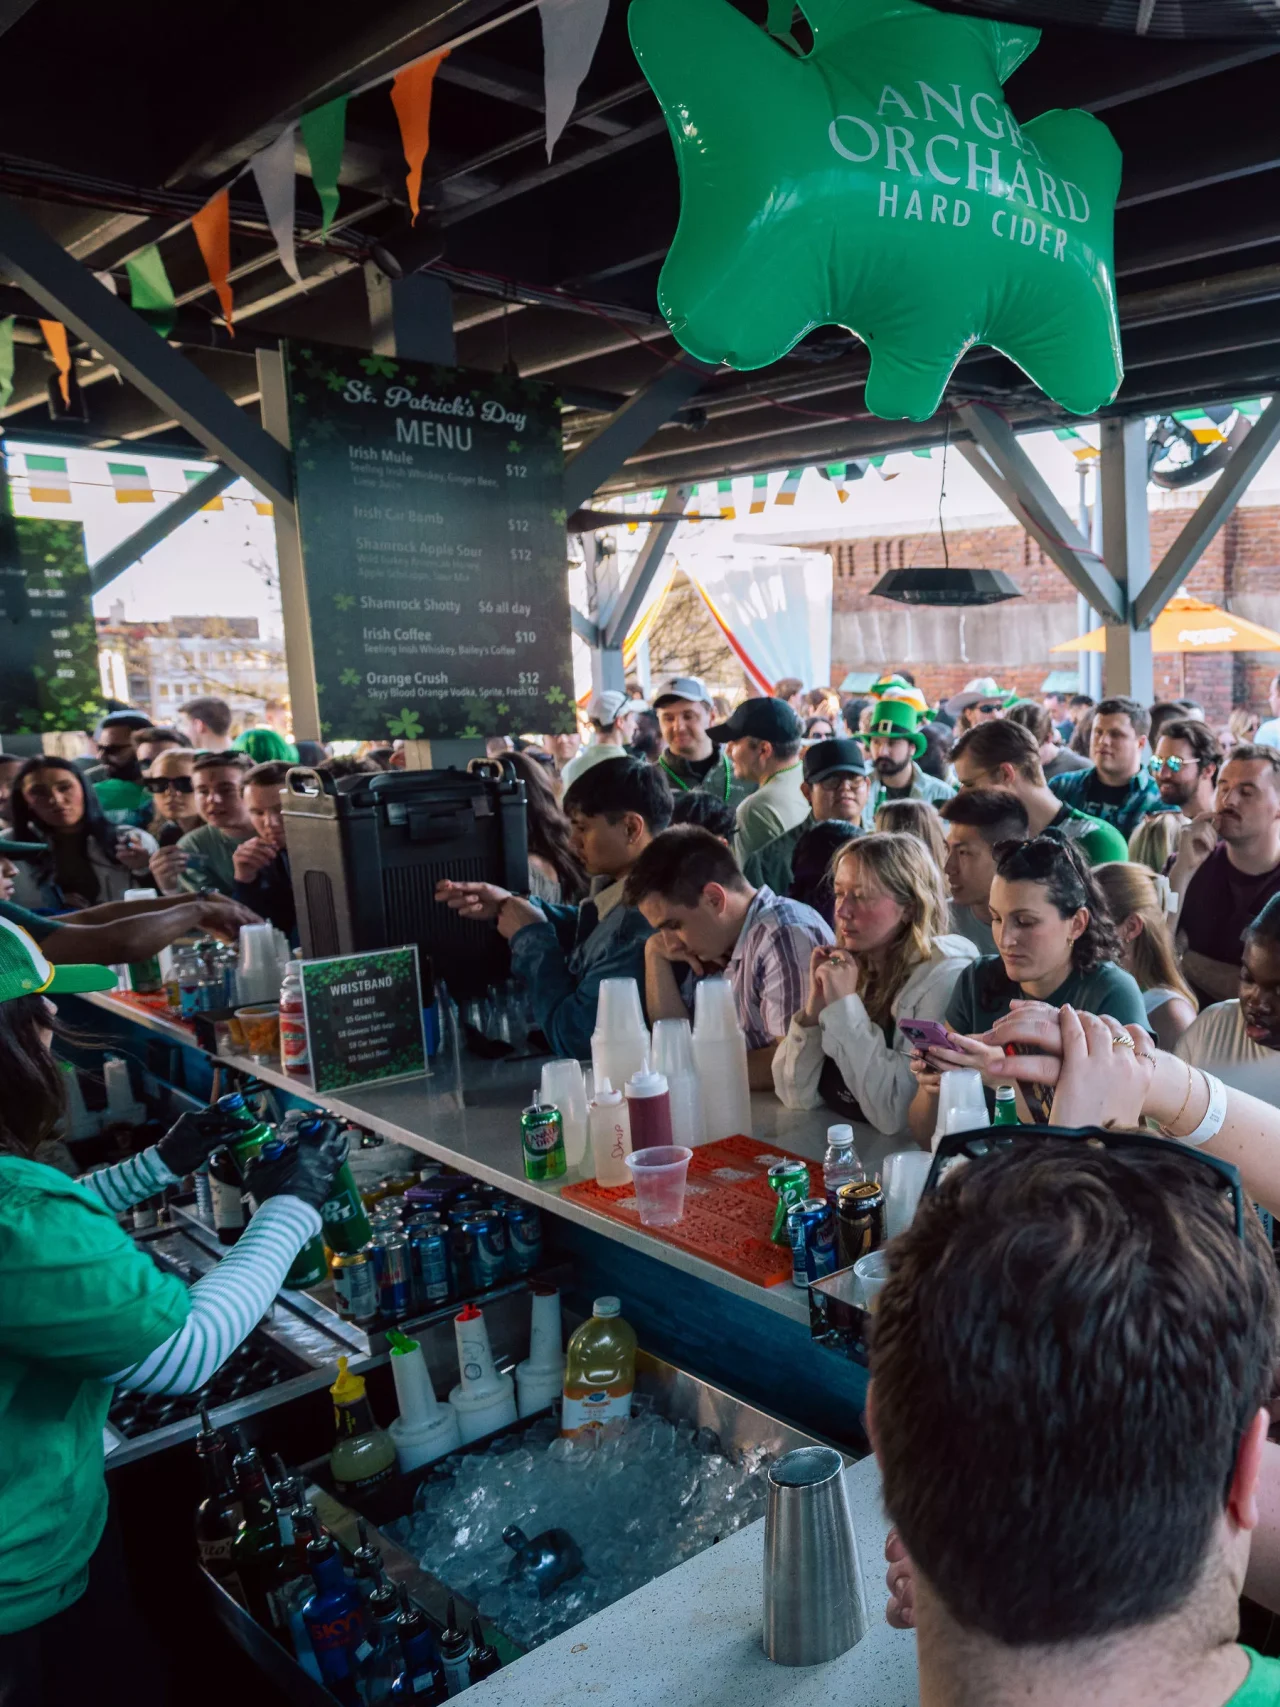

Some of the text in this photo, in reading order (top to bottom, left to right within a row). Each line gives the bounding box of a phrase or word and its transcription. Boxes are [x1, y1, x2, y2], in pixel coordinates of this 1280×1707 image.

[828, 114, 1090, 223] ORCHARD
[878, 181, 1068, 262] HARD CIDER
[343, 379, 527, 432] St. Patrick's Day
[395, 417, 473, 451] MENU
[349, 445, 414, 465] Irish Mule
[505, 464, 528, 478] $12
[353, 505, 444, 525] Irish Car Bomb
[507, 518, 530, 532] $12
[355, 536, 483, 558] Shamrock Apple Sour
[510, 548, 532, 562] $12
[359, 596, 461, 615] Shamrock Shotty
[478, 599, 531, 618] $6 all day
[363, 627, 433, 642] Irish Coffee
[515, 630, 537, 644] $10
[490, 645, 516, 656] Coffee
[366, 671, 449, 687] Orange Crush
[518, 671, 540, 685] $12
[391, 687, 416, 698] Blood
[417, 688, 449, 699] Orange
[450, 687, 476, 698] Vodka,
[506, 686, 527, 697] Fresh
[528, 686, 538, 697] OJ
[329, 976, 393, 997] WRISTBAND
[352, 996, 376, 1008] MENU
